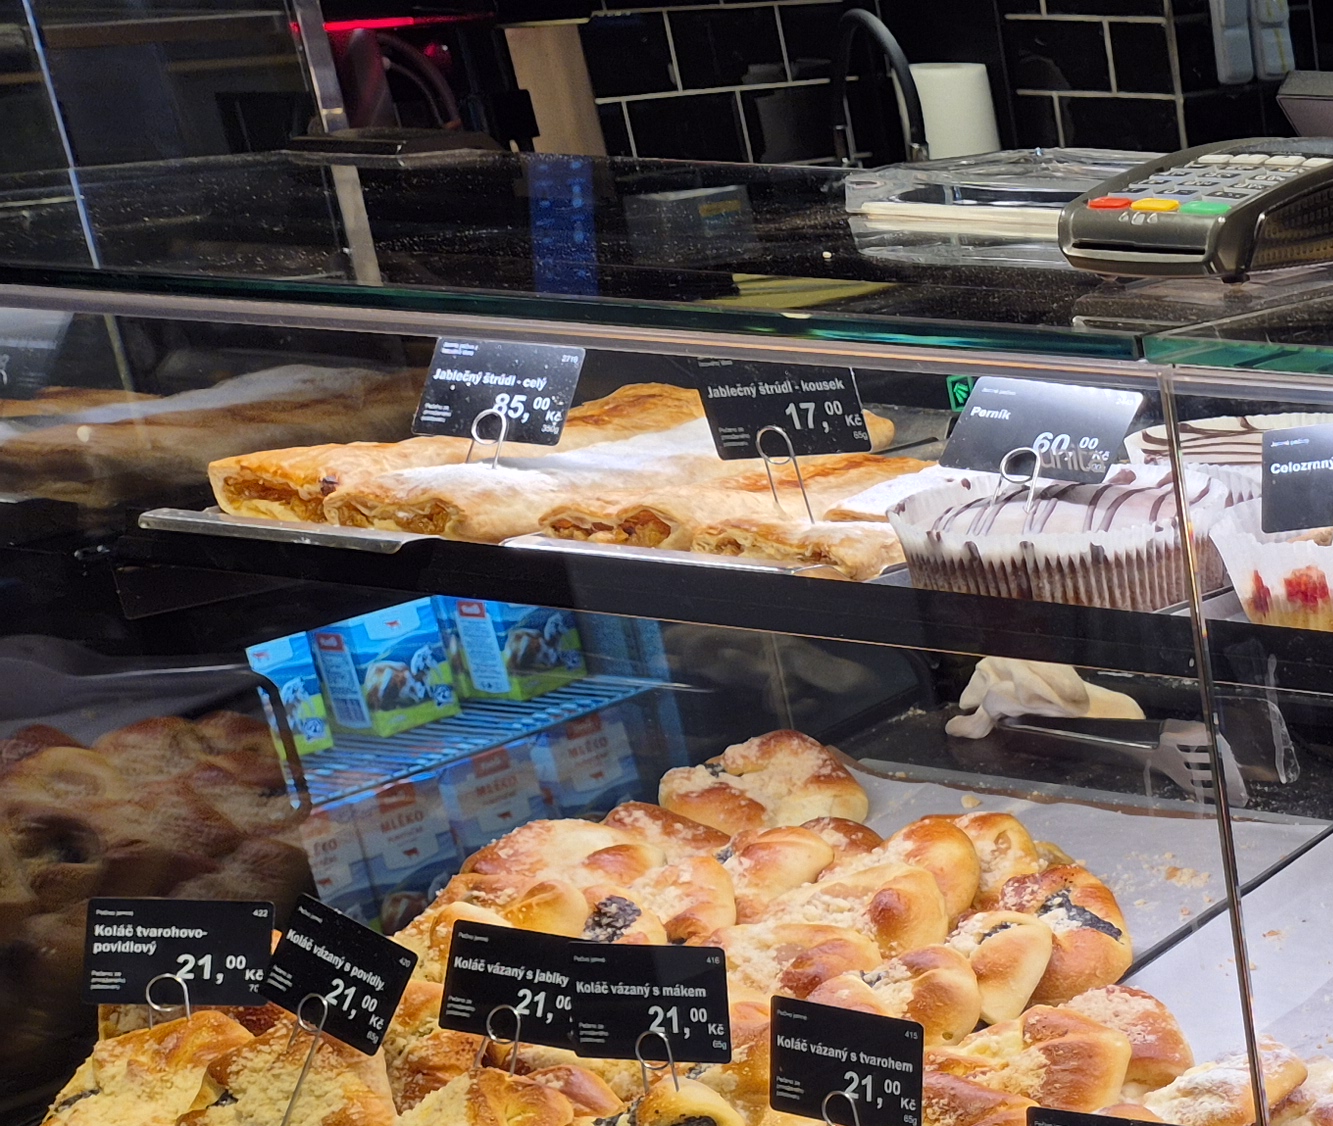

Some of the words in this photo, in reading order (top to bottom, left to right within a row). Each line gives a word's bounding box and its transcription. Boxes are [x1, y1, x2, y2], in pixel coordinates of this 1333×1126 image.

[433, 368, 483, 385] Jablečný
[523, 377, 547, 391] celý
[708, 383, 757, 398] Jablečný
[758, 380, 792, 395] štrúdl
[801, 378, 845, 392] kousek
[493, 393, 550, 424] 85,00
[545, 409, 562, 422] Kč
[785, 400, 843, 433] 17,00
[845, 414, 862, 426] Kč
[970, 406, 1012, 420] Perník
[252, 909, 268, 918] 422
[93, 924, 134, 937] Koláč
[136, 925, 208, 939] tvarohovo-
[92, 941, 157, 956] povidlový
[286, 928, 314, 951] Koláč
[312, 944, 345, 970] vázaný
[176, 953, 247, 984] 21,00
[245, 969, 264, 981] Kč
[453, 956, 485, 972] Koláč
[487, 962, 525, 980] vázaný
[525, 969, 533, 980] s
[533, 968, 570, 988] jablky
[325, 978, 378, 1020] 21,00
[369, 1014, 385, 1030] Kč
[576, 980, 609, 994] Koláč
[610, 982, 650, 997] vázaný
[652, 986, 660, 997] s
[662, 984, 707, 997] mákem
[515, 988, 572, 1025] 21,00
[647, 1005, 708, 1040] 21,00
[707, 1023, 725, 1035] Kč
[905, 1030, 918, 1040] 415
[777, 1035, 808, 1052] Koláč
[809, 1043, 848, 1062] vázaný
[850, 1051, 857, 1062] s
[859, 1051, 913, 1073] tvarohem
[843, 1071, 901, 1109] 21,00
[900, 1097, 916, 1111] Kč
